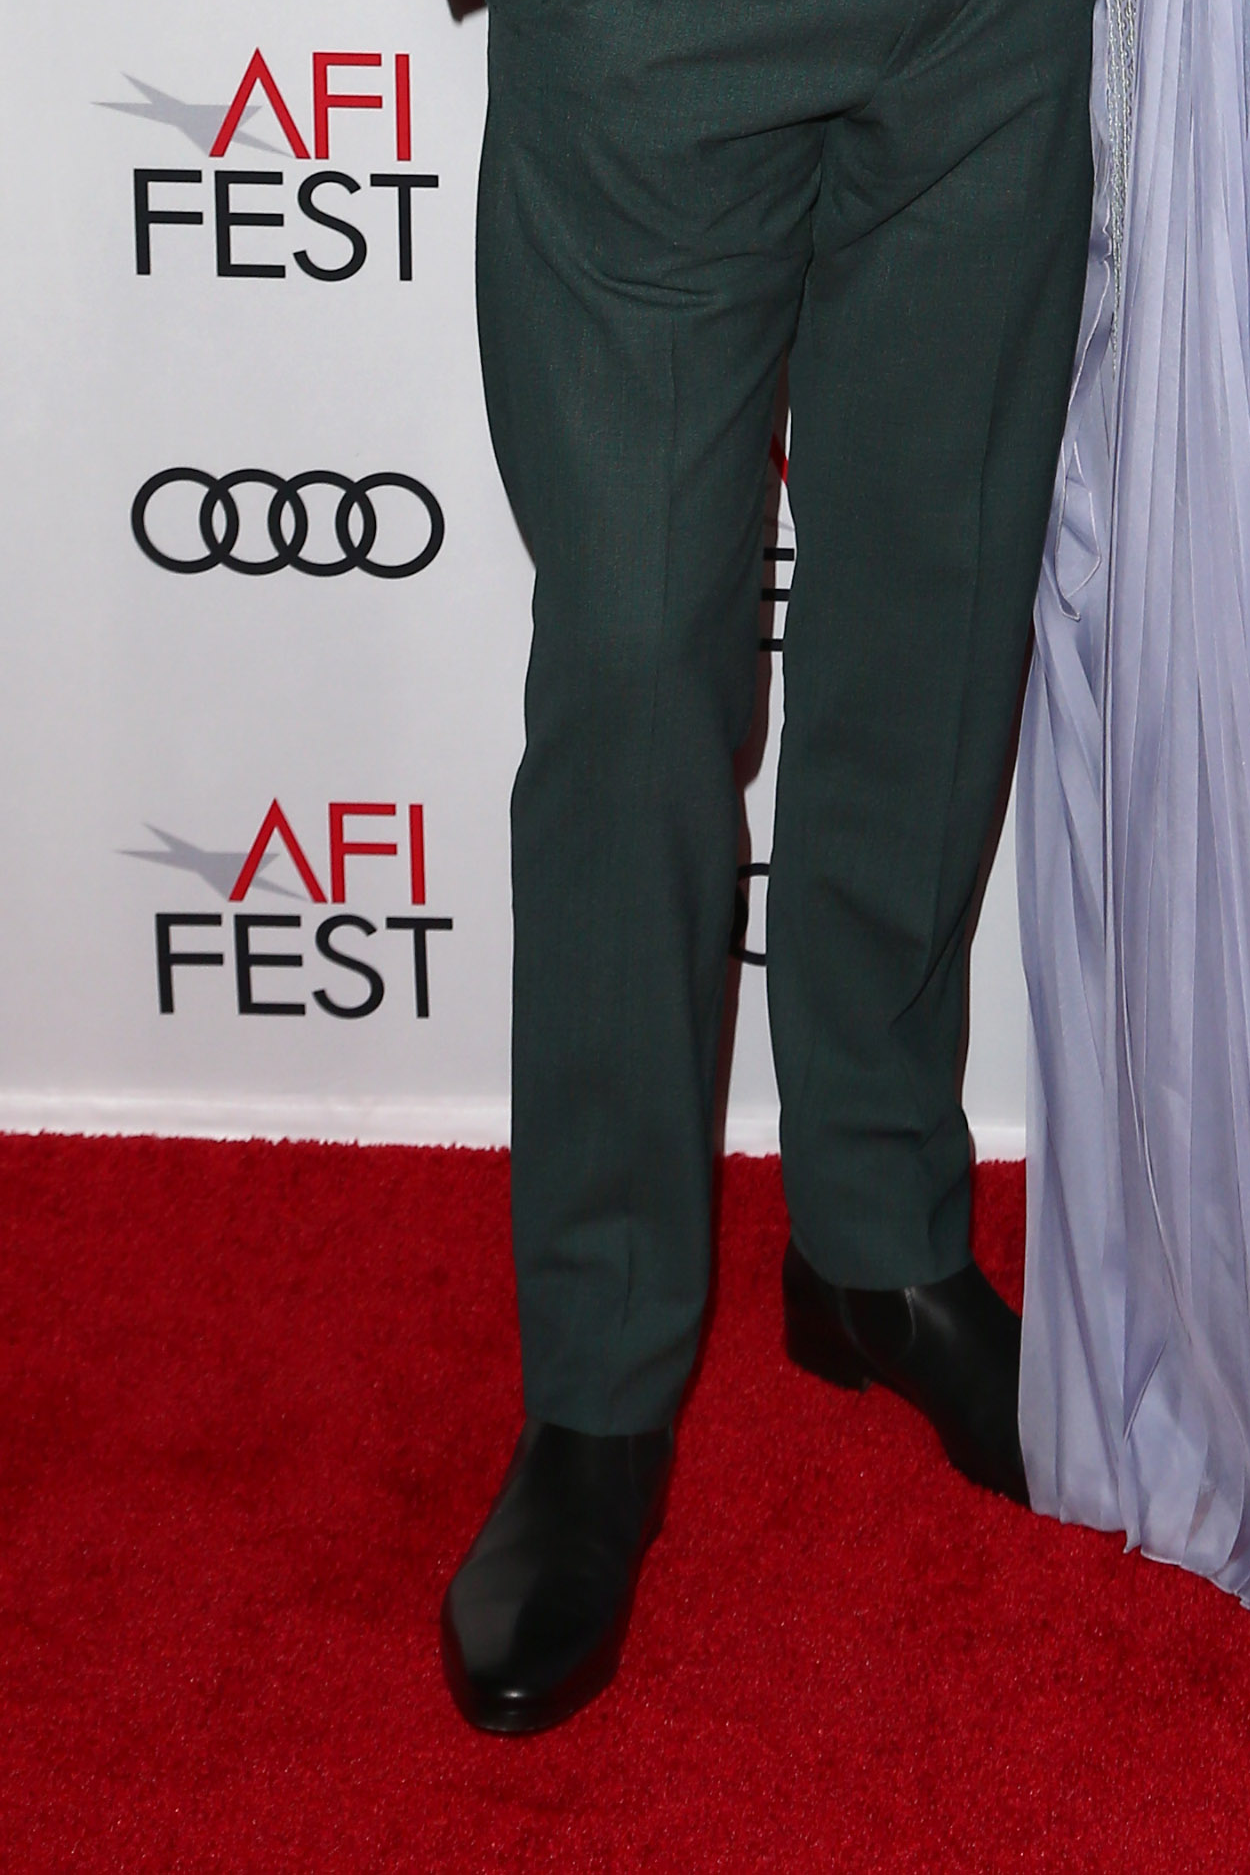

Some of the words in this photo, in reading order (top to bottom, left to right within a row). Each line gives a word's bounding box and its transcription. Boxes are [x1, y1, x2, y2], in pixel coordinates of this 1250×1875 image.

[209, 47, 412, 162] AFI
[133, 168, 439, 282] FEST
[228, 798, 426, 906] AFI
[155, 912, 453, 1019] FEST
